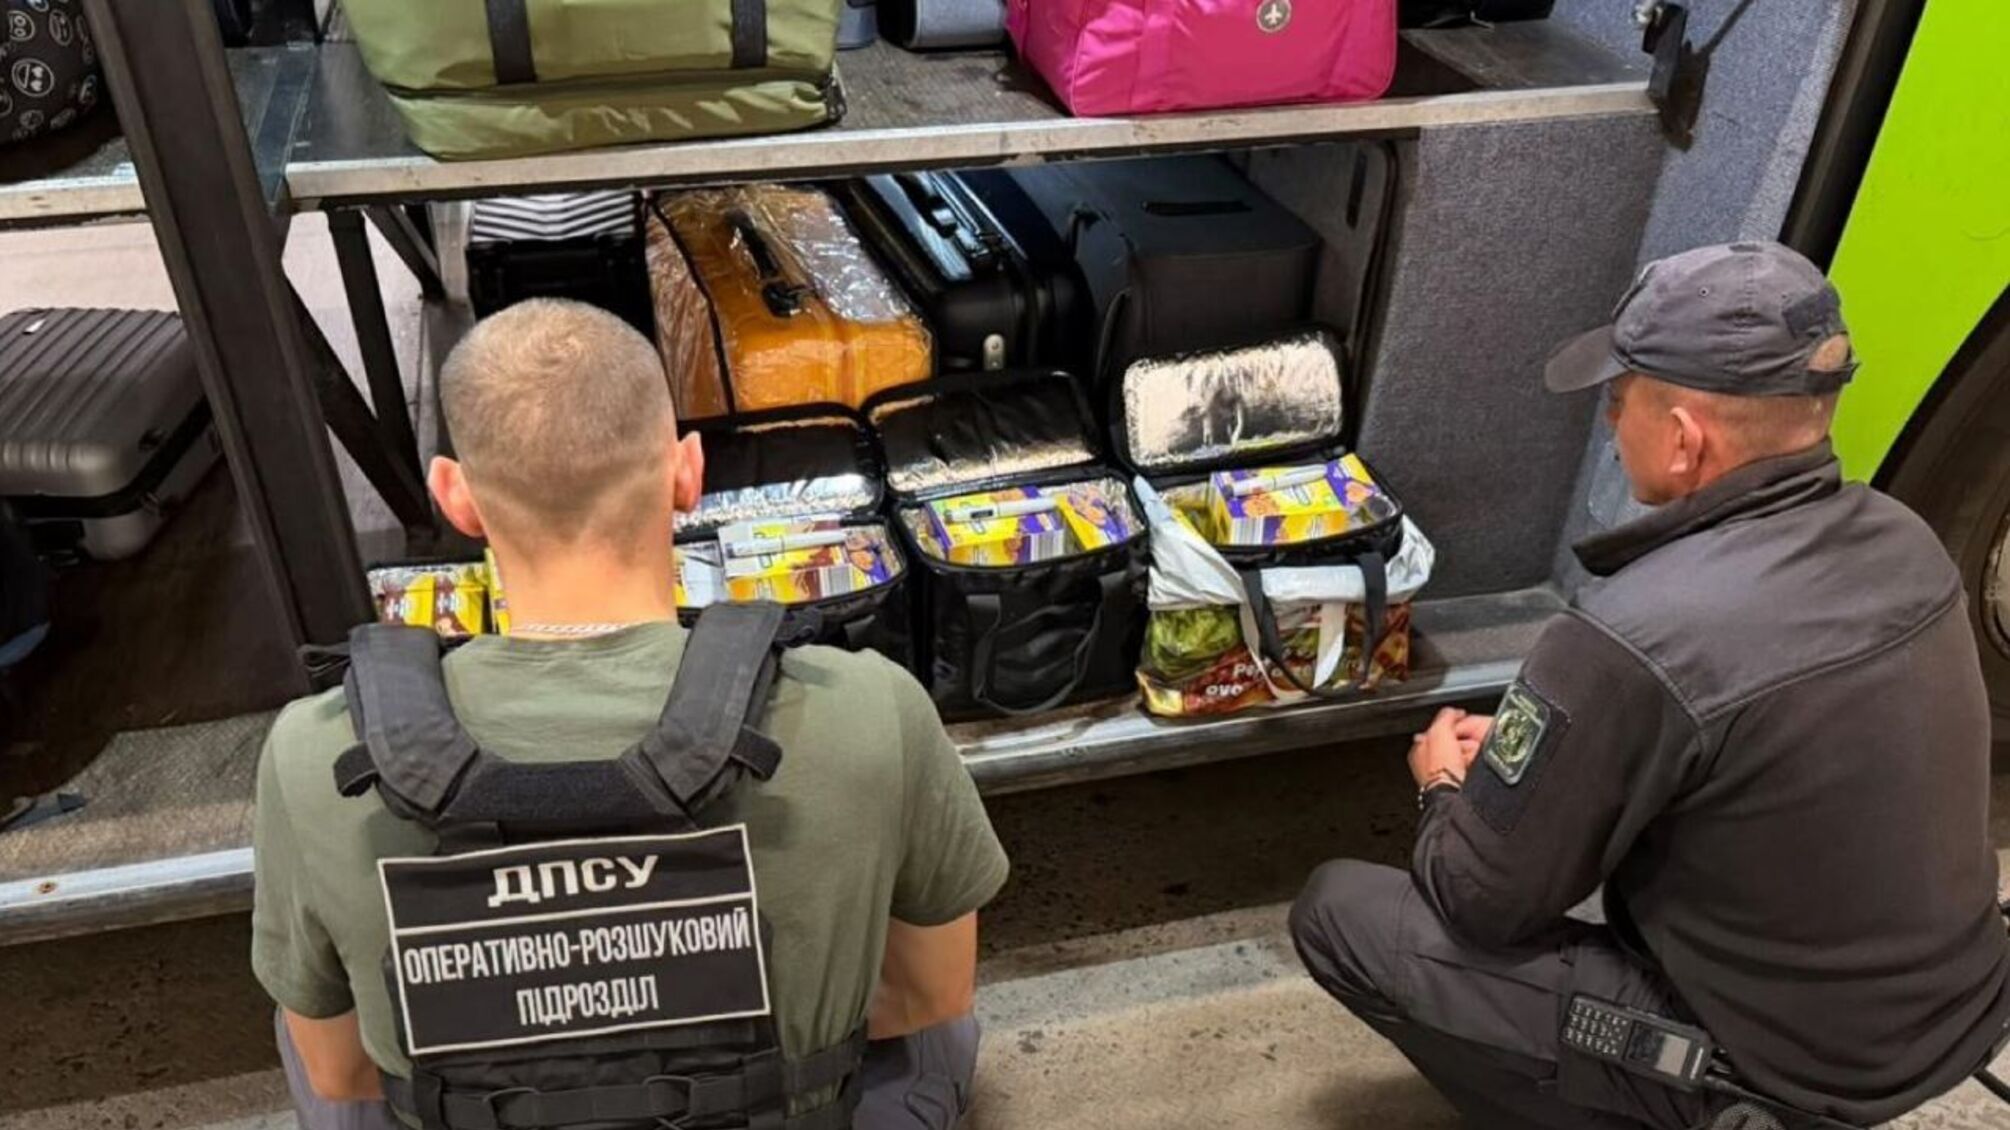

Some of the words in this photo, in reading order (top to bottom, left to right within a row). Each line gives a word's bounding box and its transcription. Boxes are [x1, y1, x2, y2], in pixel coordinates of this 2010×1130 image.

[488, 855, 659, 907] ДПСУ
[404, 907, 751, 984] ОПЕРАТИВНО-РОЗШУКОВИЙ
[516, 975, 660, 1027] ПІДРОЗДІЛ
